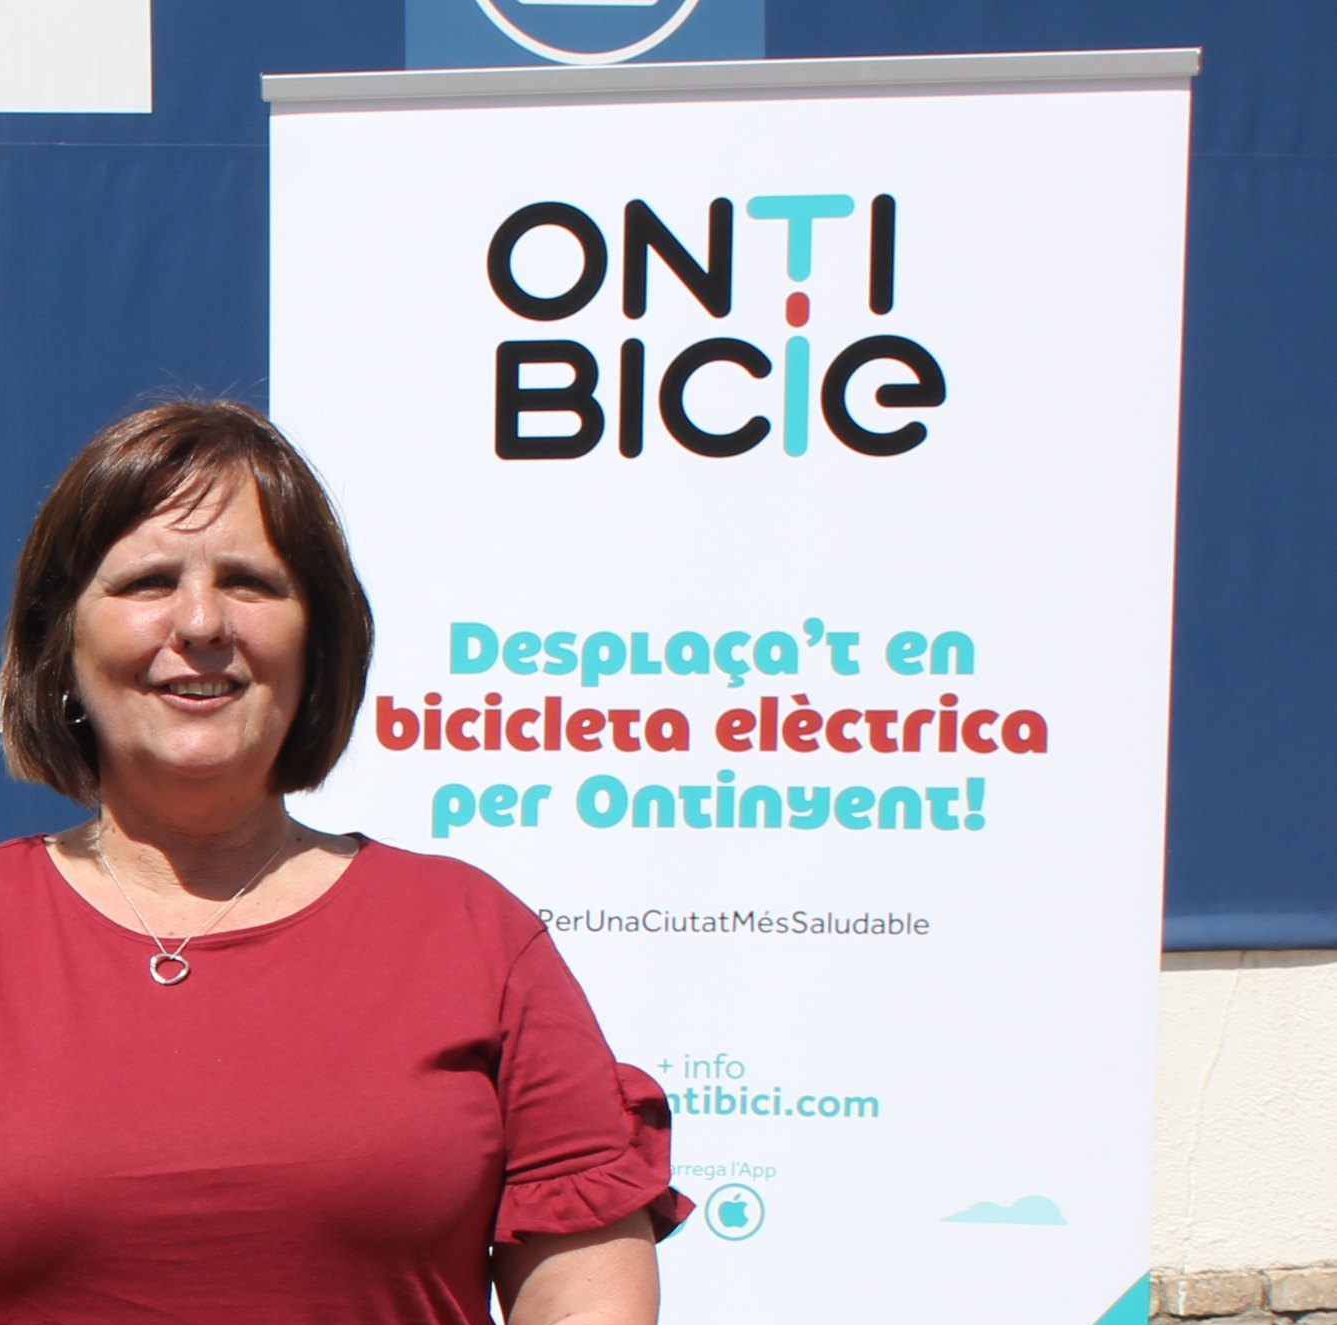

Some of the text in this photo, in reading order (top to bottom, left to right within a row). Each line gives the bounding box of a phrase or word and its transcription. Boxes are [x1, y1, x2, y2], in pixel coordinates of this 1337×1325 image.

[487, 193, 896, 322] ONTI
[887, 631, 975, 675] en
[376, 692, 1048, 754] bicicleta elèctrica
[431, 769, 986, 840] per Ontinyent!
[683, 1052, 747, 1080] info
